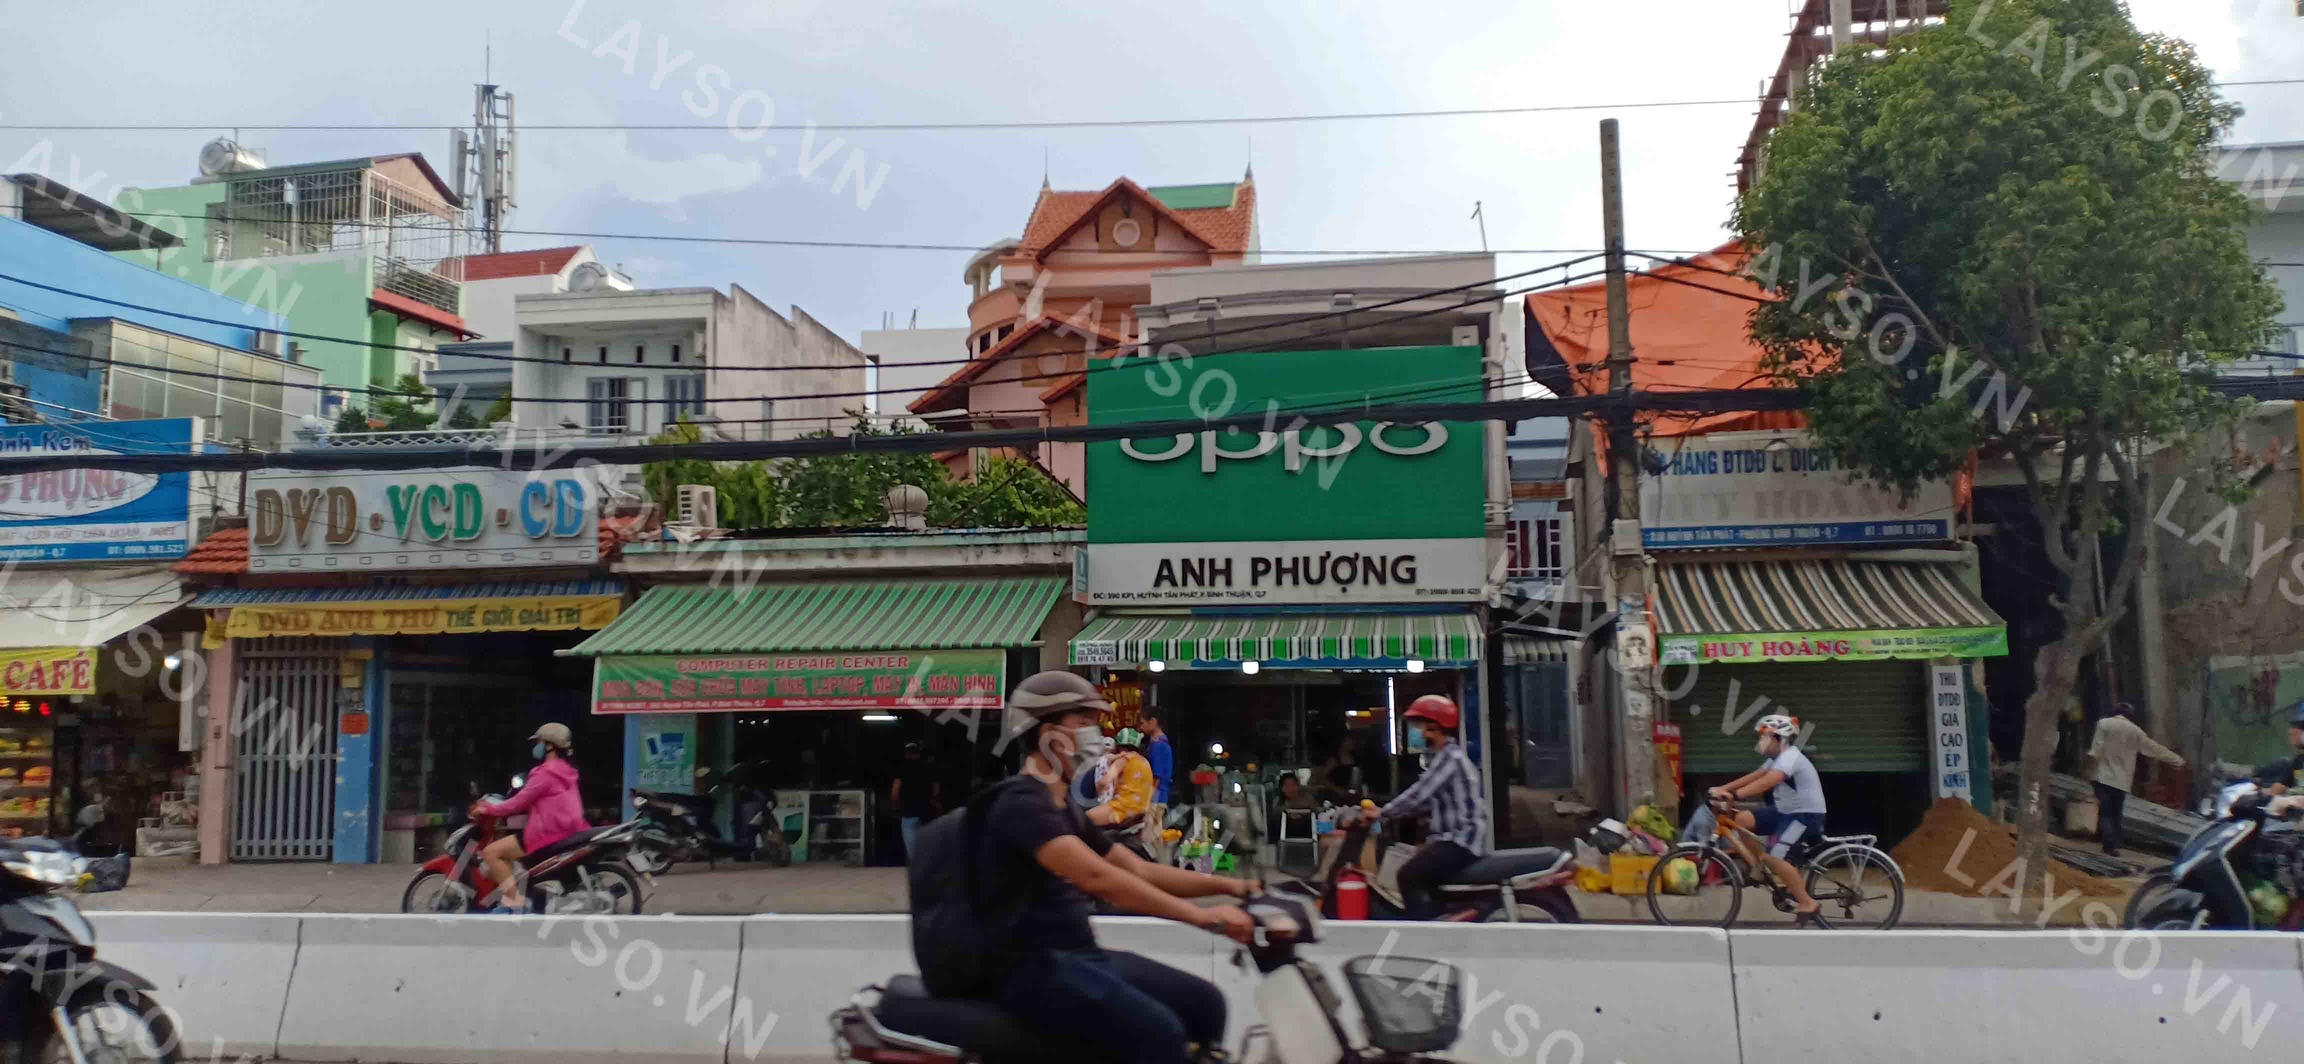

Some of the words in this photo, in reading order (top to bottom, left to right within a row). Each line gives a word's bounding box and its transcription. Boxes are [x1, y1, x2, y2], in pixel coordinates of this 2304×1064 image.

[254, 486, 359, 546] DVD
[386, 482, 484, 542] VCD
[520, 479, 587, 539] CD
[1153, 557, 1232, 588] ANH
[1251, 551, 1417, 593] PHƯỢNG
[258, 610, 309, 630] DVD
[319, 609, 373, 629] ANH
[384, 606, 441, 628] THƯ
[446, 604, 475, 627] THẾ
[482, 604, 513, 626] GIỚI
[519, 602, 549, 625] GIẢI
[555, 602, 582, 624] TRÍ
[1703, 642, 1753, 658] HUY
[1762, 636, 1850, 657] HOÀNG
[4, 651, 91, 690] CAFÉ
[677, 658, 768, 673] COMPUTER
[776, 656, 837, 670] REPAIR
[843, 655, 909, 669] CENTER
[1941, 733, 1963, 747] CAO
